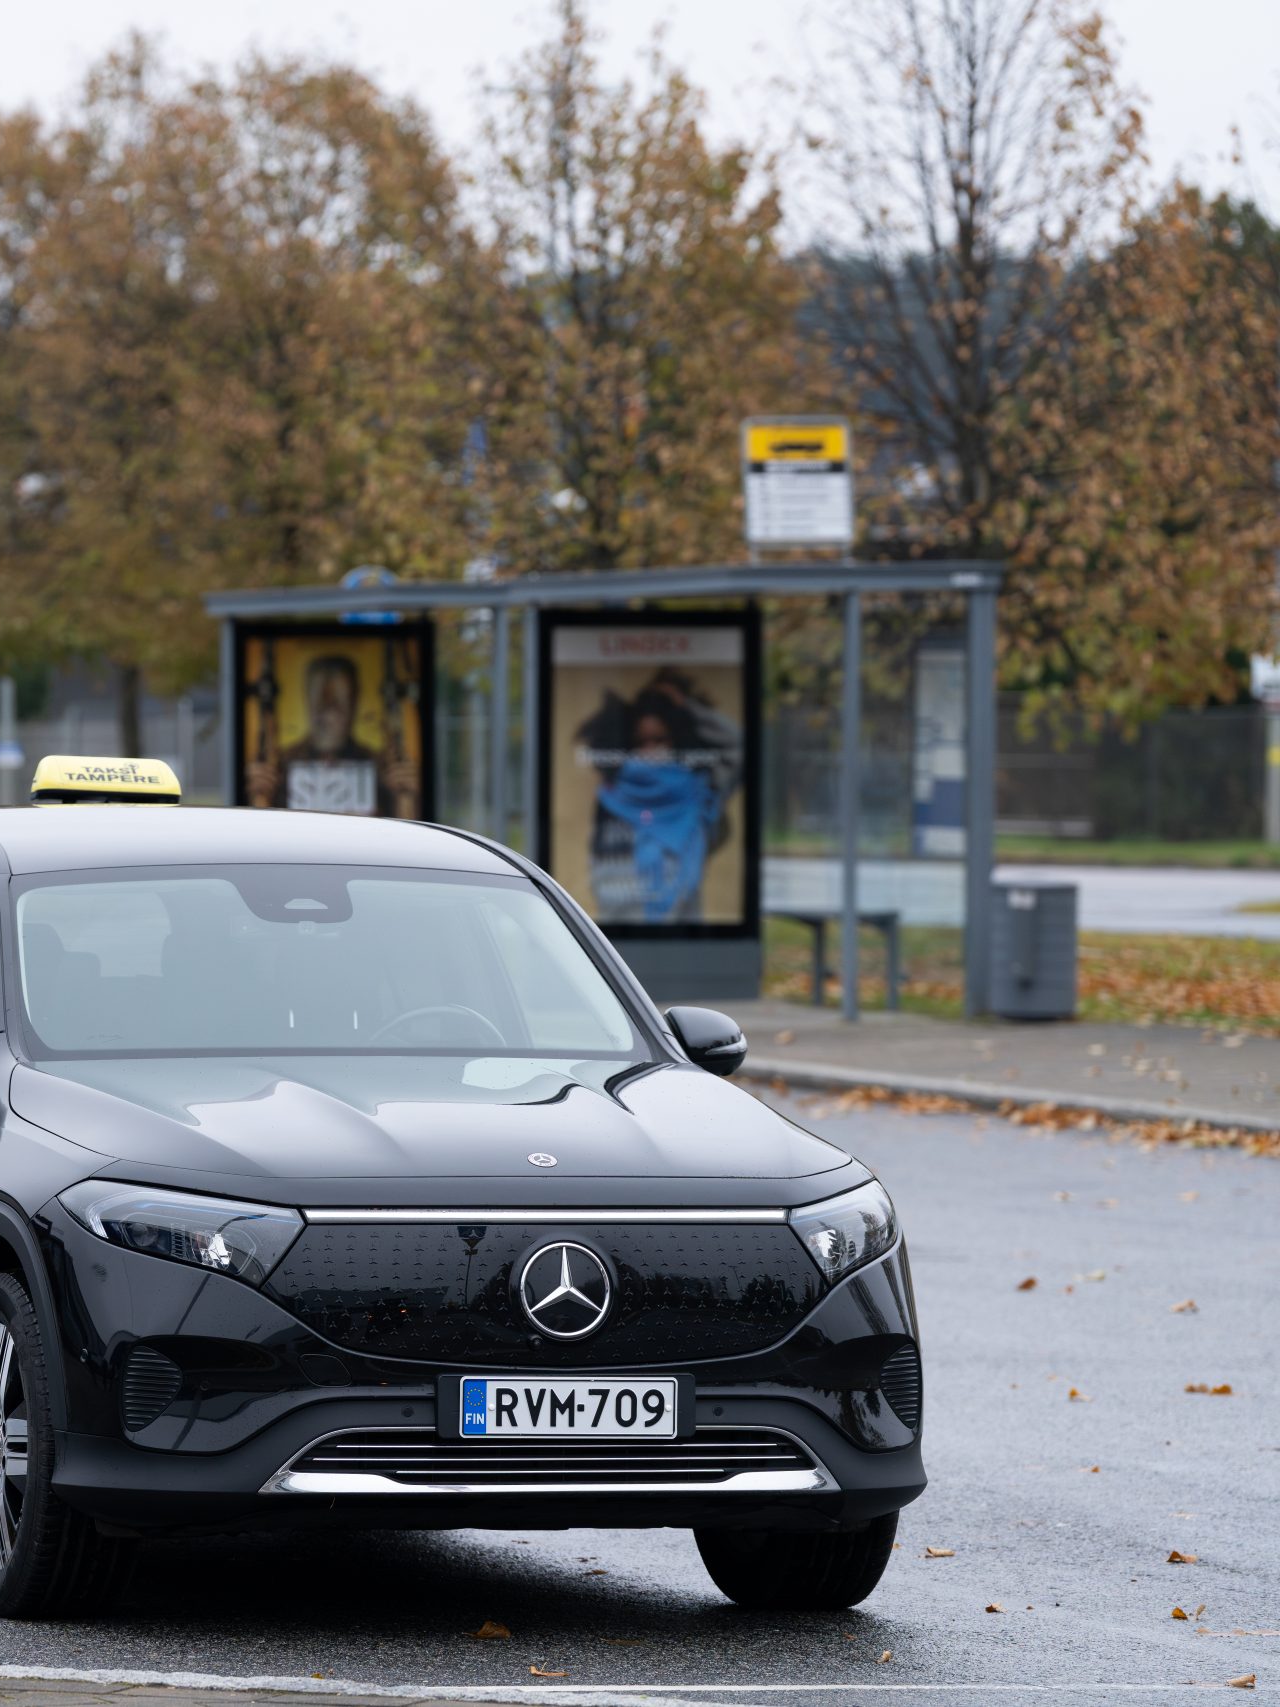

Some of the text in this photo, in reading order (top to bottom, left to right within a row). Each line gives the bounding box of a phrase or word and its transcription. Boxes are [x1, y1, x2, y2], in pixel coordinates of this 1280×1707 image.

[82, 766, 138, 775] TAKSI
[64, 772, 161, 784] TAMPERE
[495, 1387, 665, 1428] RVM-709
[465, 1412, 485, 1425] FIN
